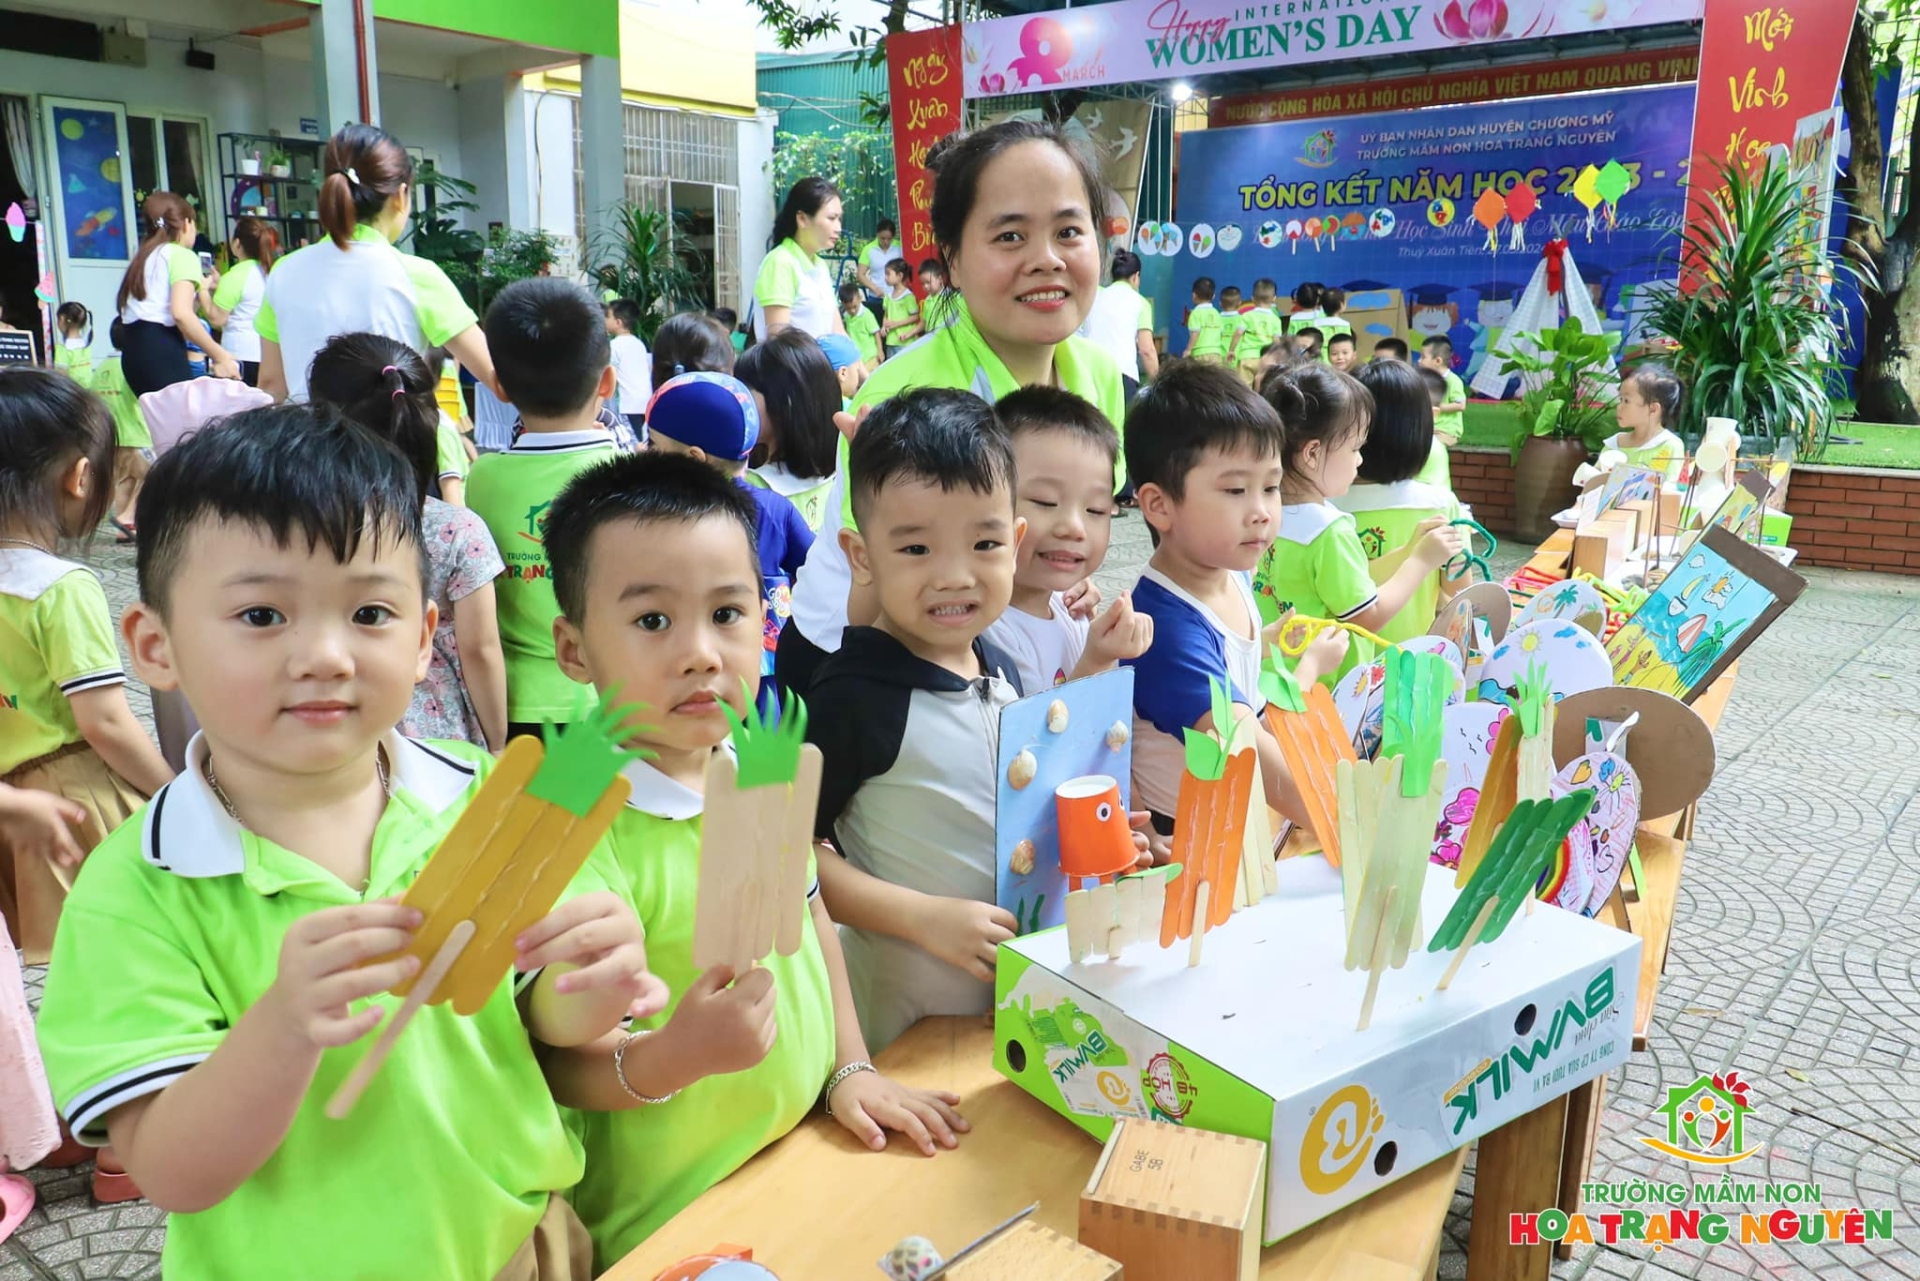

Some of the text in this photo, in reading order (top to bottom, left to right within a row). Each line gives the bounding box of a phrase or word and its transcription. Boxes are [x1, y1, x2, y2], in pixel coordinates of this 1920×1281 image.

[1147, 0, 1231, 57] Happy
[1335, 5, 1422, 48] DAY
[1744, 8, 1794, 52] Mới
[903, 48, 948, 89] Ngày
[1063, 65, 1105, 82] MARCH
[1267, 97, 1307, 119] CỘNG
[1312, 92, 1341, 112] HÒA
[1346, 90, 1367, 109] XÃ
[1372, 87, 1398, 108] HỘI
[1401, 79, 1433, 103] CHỦ
[1438, 75, 1489, 100] NGHĨA
[1495, 73, 1531, 95] VIỆT
[1536, 69, 1579, 89] NAM
[1584, 63, 1652, 86] QUANG
[1380, 128, 1406, 143] BAN
[1479, 118, 1524, 135] HUYỆN
[1527, 114, 1588, 131] CHƯƠNG
[1592, 110, 1615, 126] MỸ
[1442, 141, 1472, 155] NON
[1474, 138, 1504, 151] HOA
[1508, 135, 1553, 152] TRẠNG
[1556, 130, 1616, 147] NGUYÊN
[1240, 175, 1317, 210] TỔNG
[1325, 170, 1382, 206] KẾT
[1389, 168, 1463, 202] NĂM
[1052, 1031, 1107, 1083] BVMILK
[1451, 966, 1614, 1135] BVMILK
[1129, 1149, 1150, 1172] GABE
[1147, 1158, 1164, 1170] 5B
